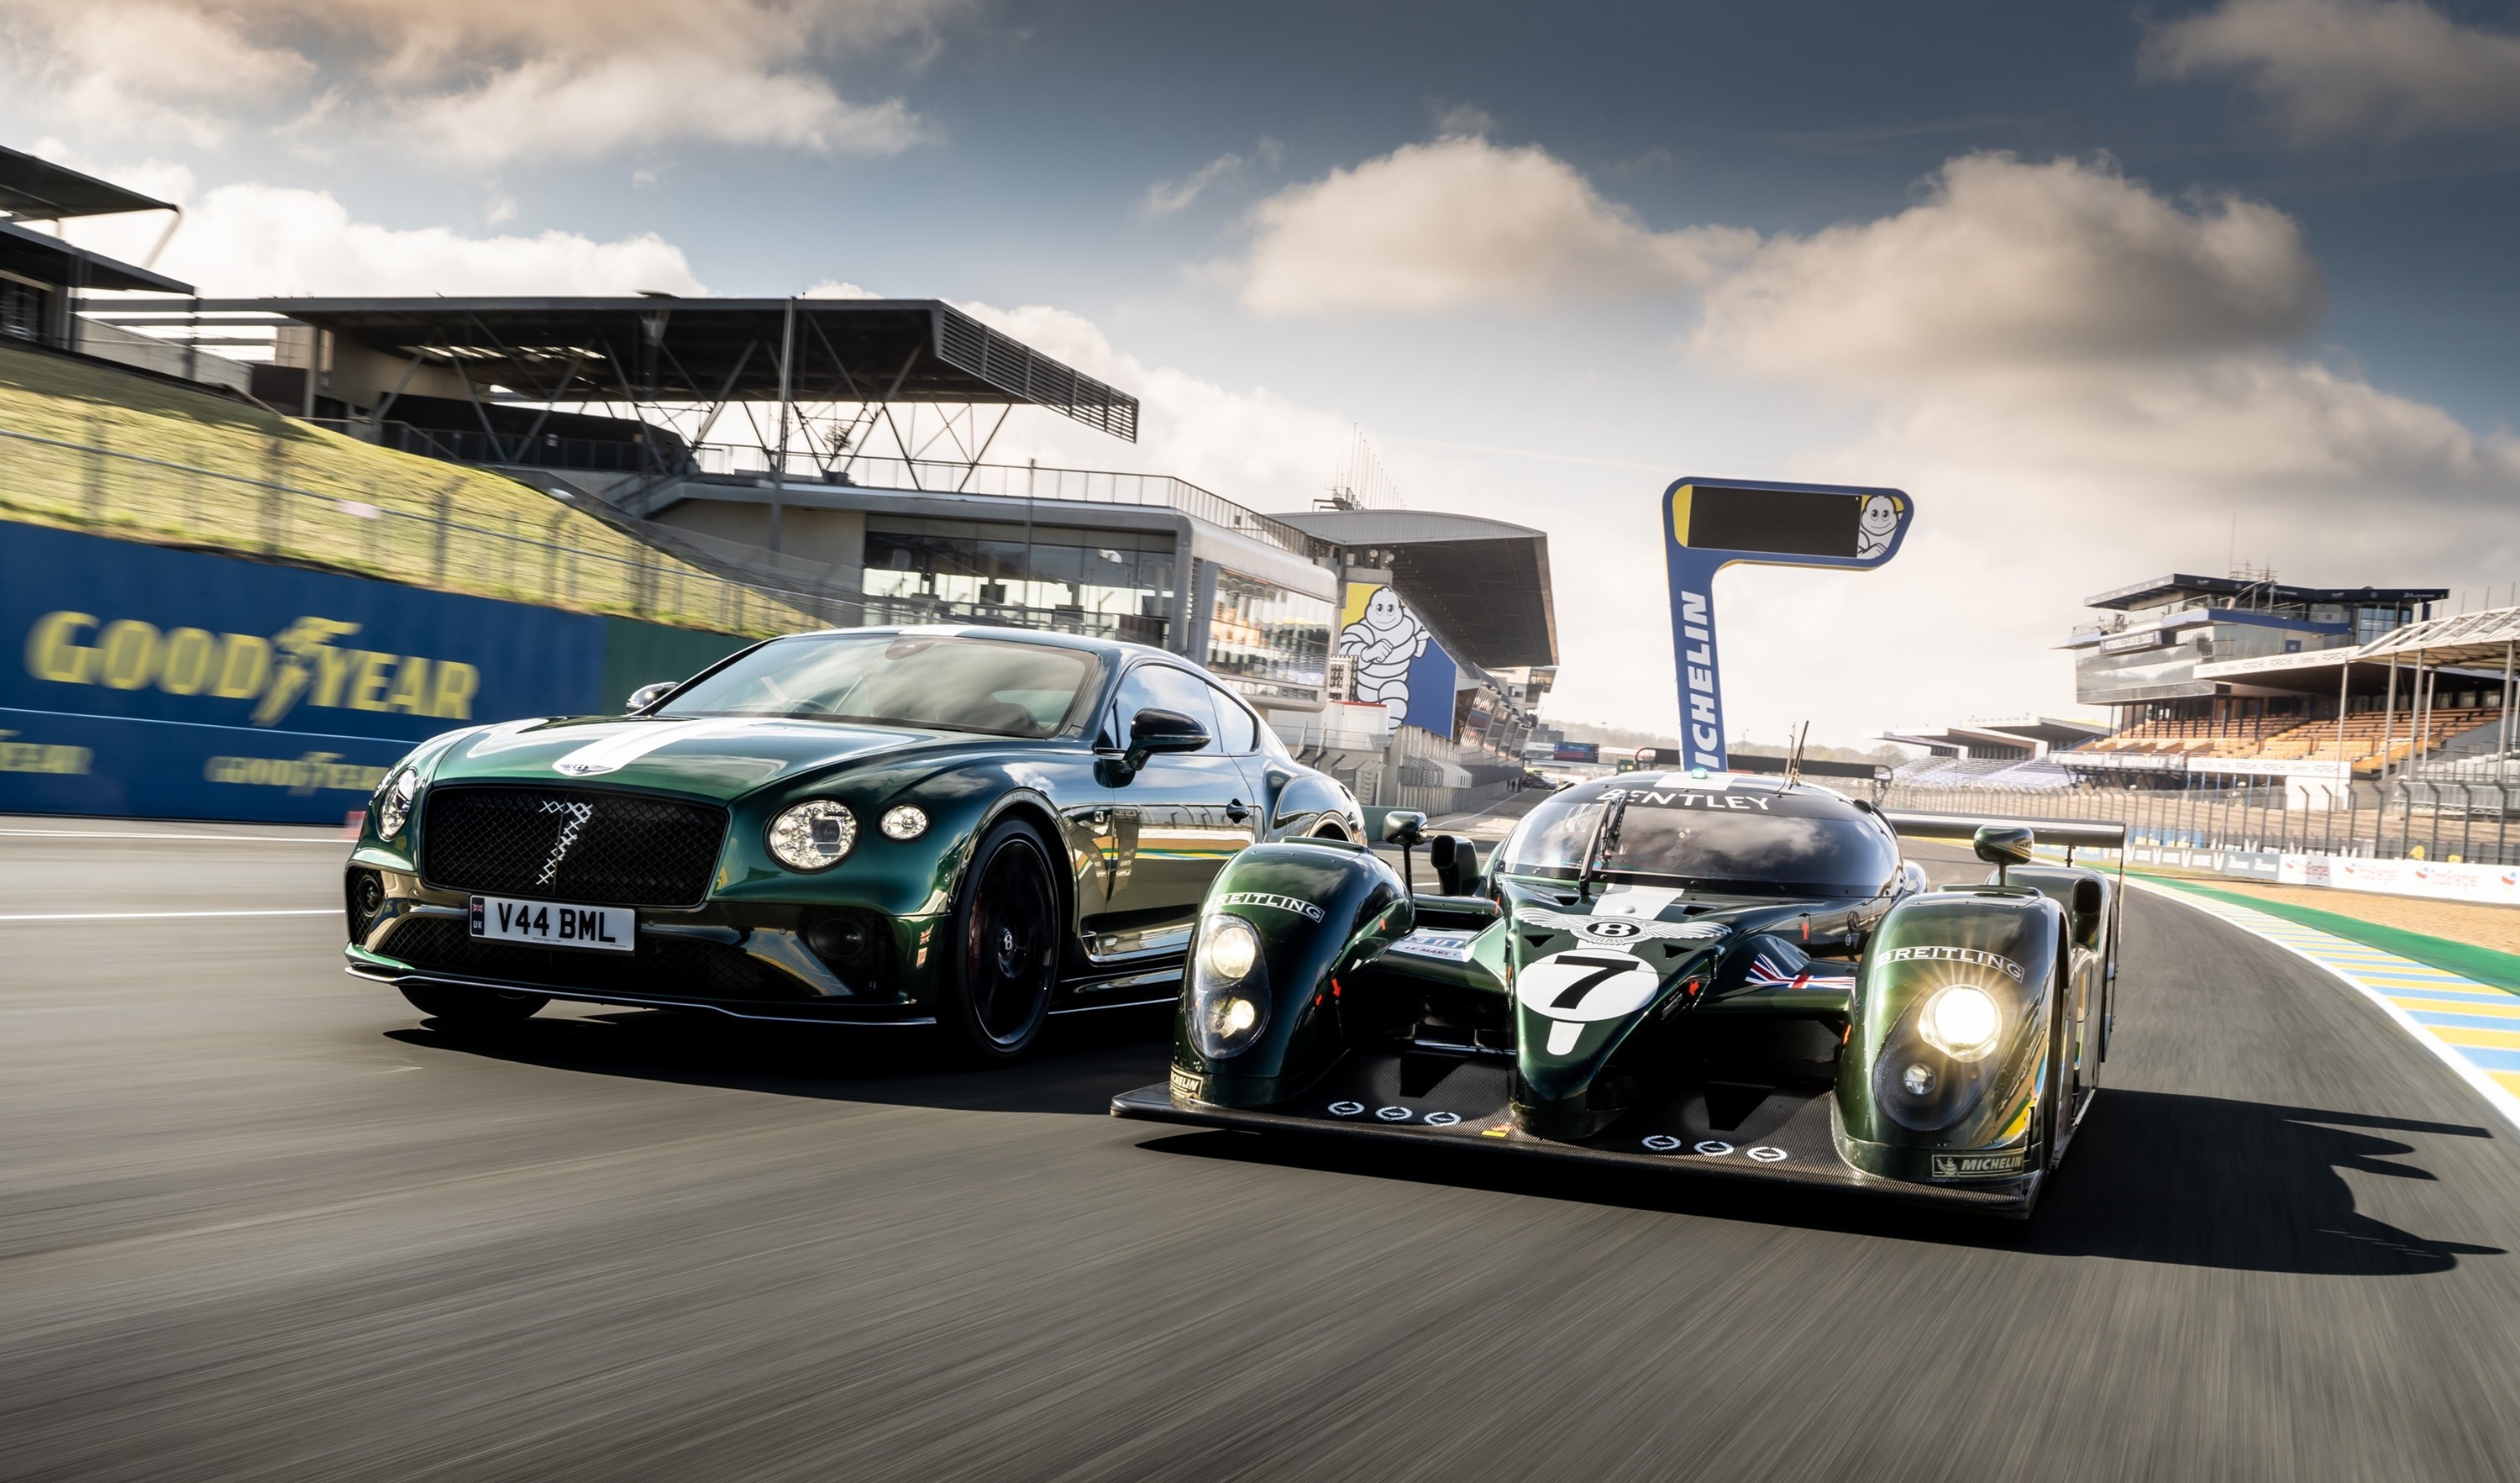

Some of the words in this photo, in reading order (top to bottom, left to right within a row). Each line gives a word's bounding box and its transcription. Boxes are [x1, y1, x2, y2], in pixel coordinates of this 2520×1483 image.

[1681, 591, 1719, 769] ICHELIN
[537, 801, 593, 884] 7
[497, 902, 550, 937] V44
[559, 908, 616, 943] BML
[1593, 923, 1632, 937] B
[1549, 954, 1641, 1009] 7
[1877, 947, 2022, 979] BREITLING
[1961, 1155, 2023, 1170] MICHELIN
